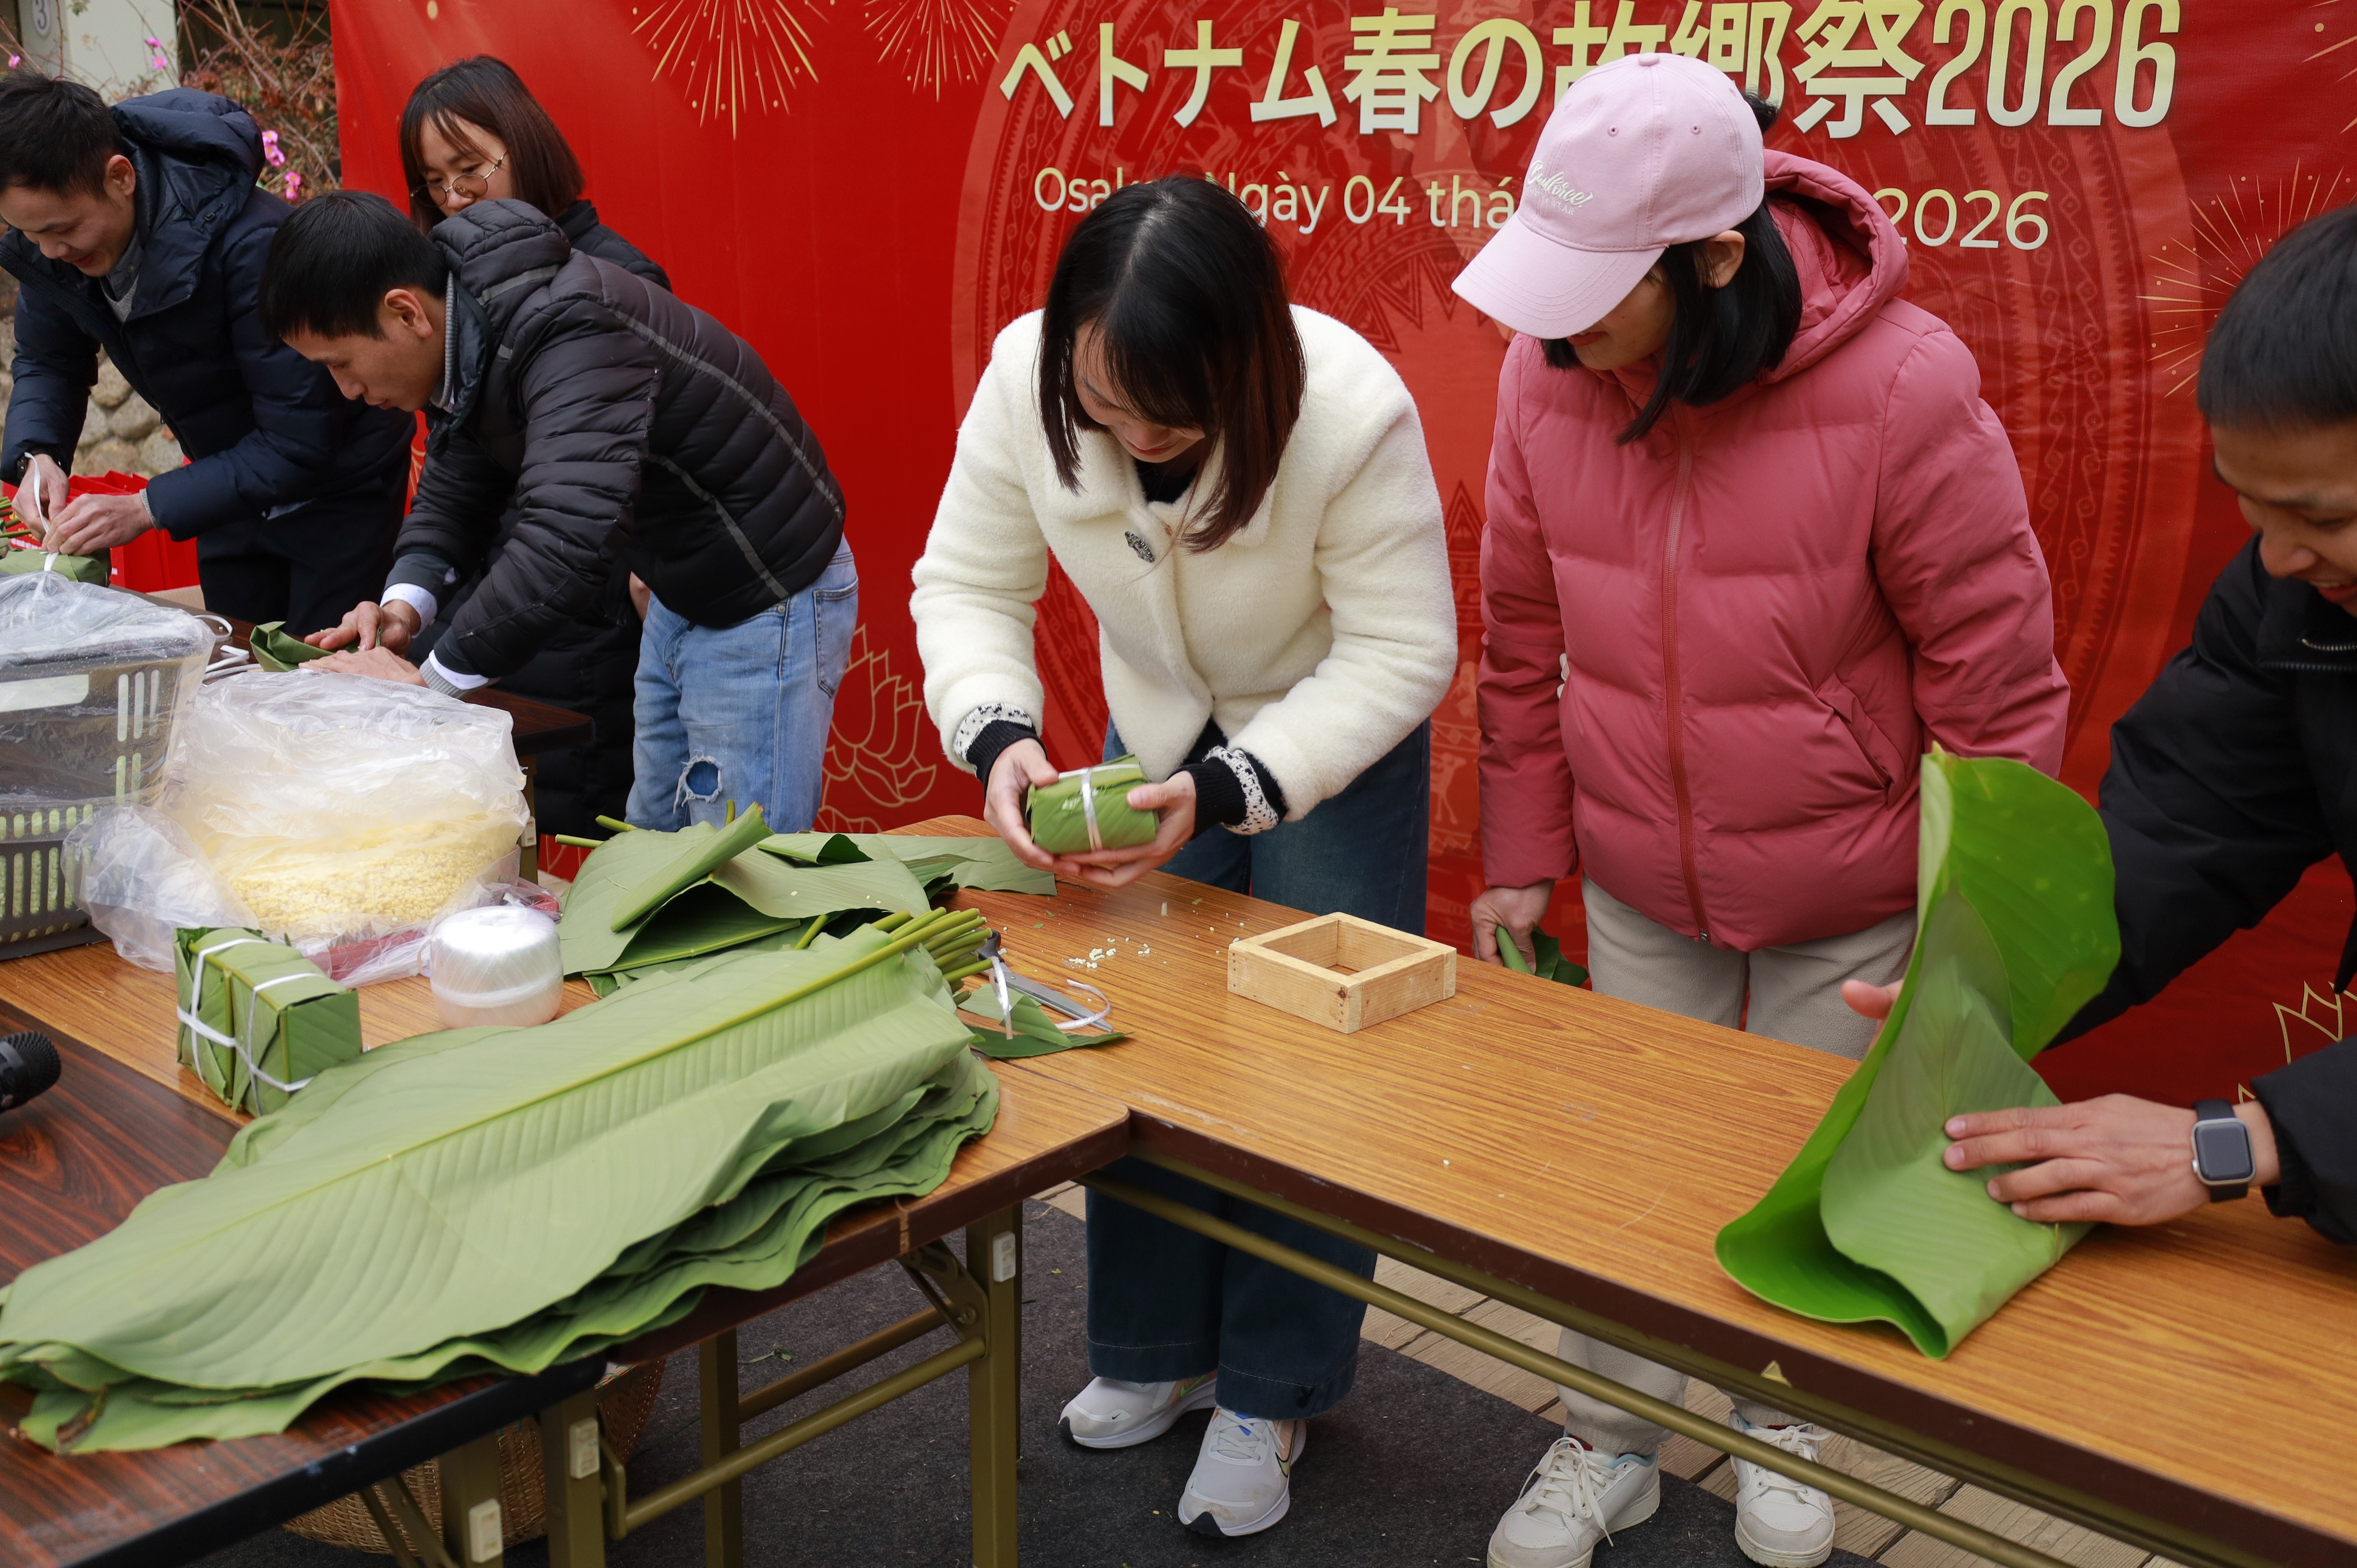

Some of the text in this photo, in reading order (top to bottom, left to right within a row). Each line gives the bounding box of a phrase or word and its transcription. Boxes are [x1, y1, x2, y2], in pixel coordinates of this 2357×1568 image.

[1034, 167, 1155, 212] Osa
[1343, 174, 1411, 225] 04
[1426, 174, 1514, 229] thá
[1872, 188, 2049, 250] 2026
[1551, 198, 1575, 216] WEAR
